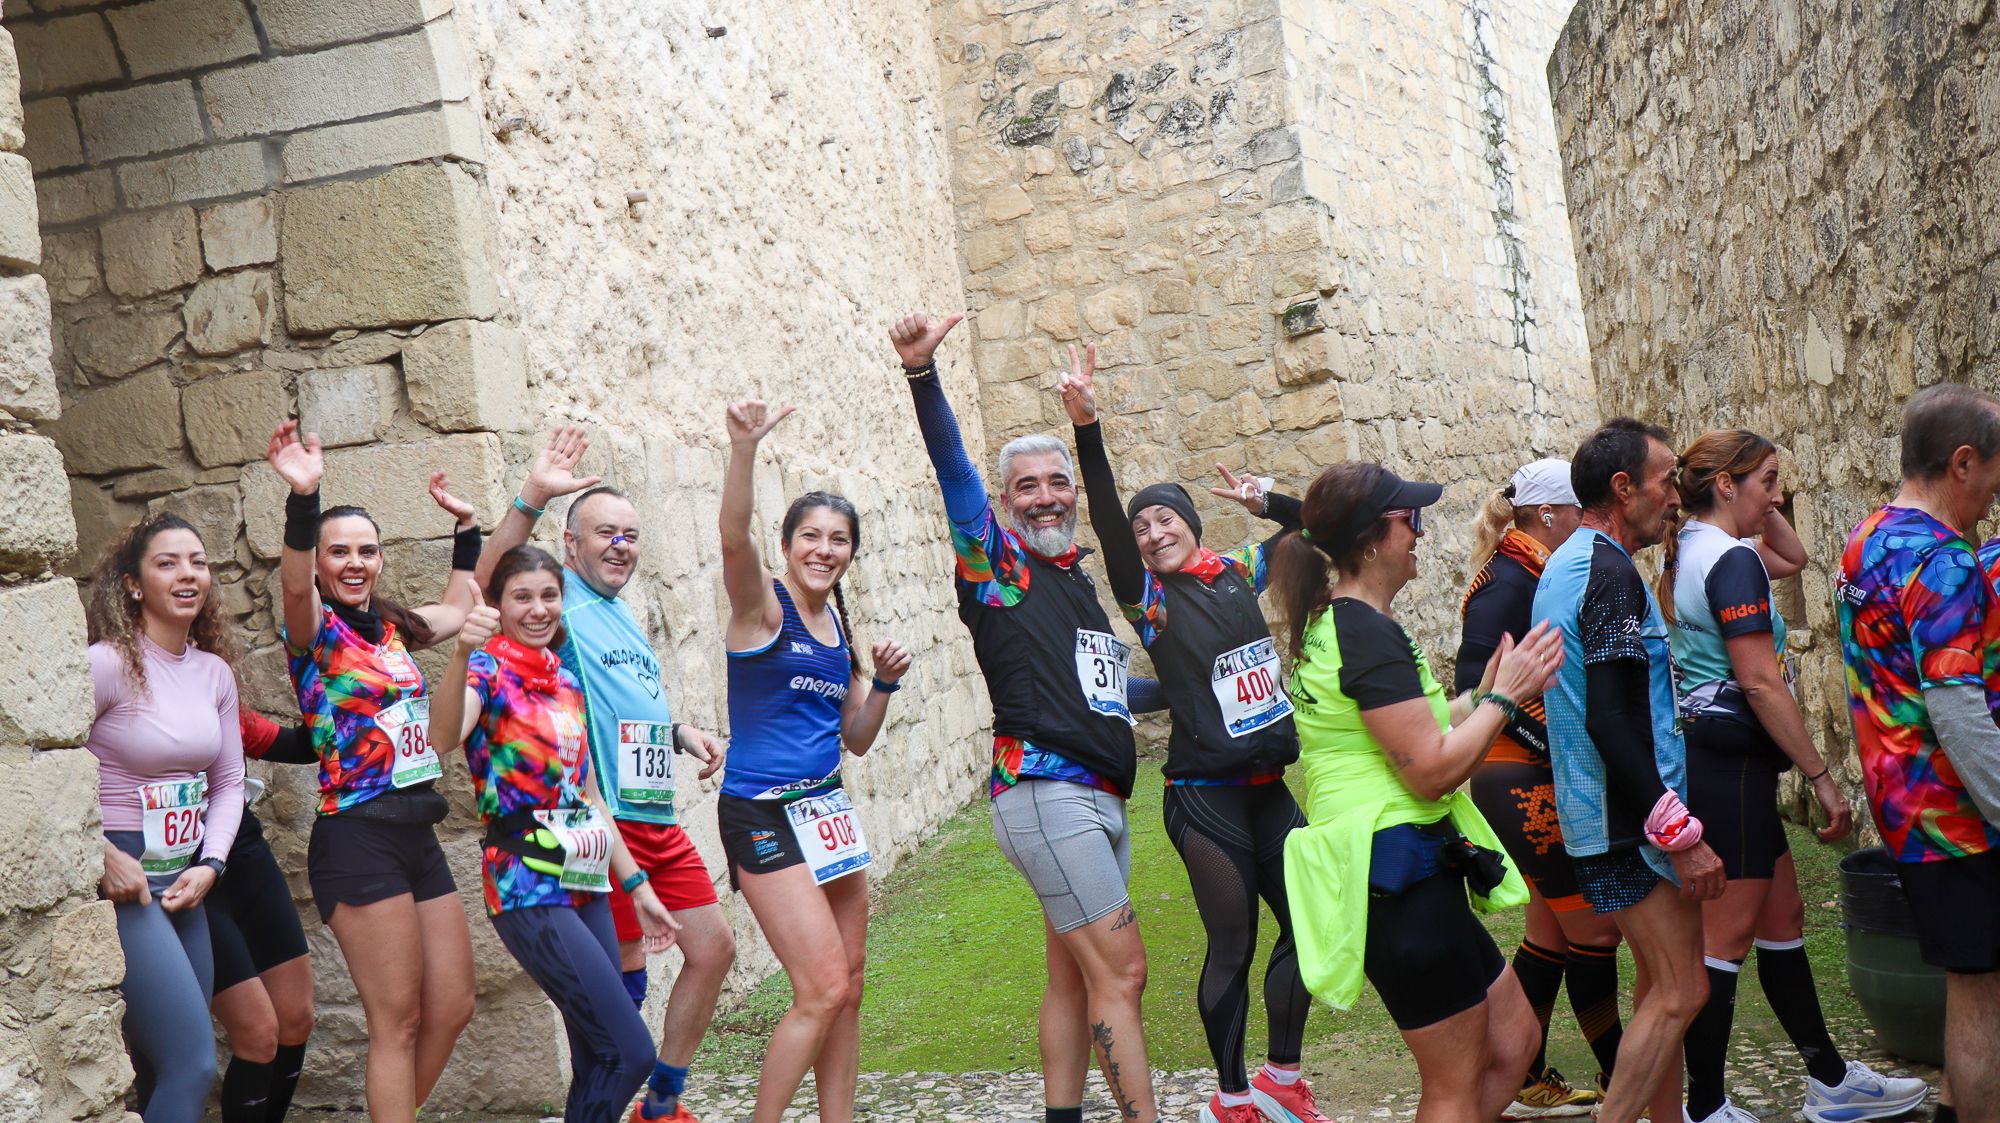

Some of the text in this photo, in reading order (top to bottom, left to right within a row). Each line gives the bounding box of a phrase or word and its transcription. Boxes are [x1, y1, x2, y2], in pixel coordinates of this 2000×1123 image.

[789, 675, 848, 701] enerplu
[1236, 667, 1274, 705] 400
[626, 724, 653, 745] 10K
[1516, 725, 1547, 752] KIPRUN
[631, 746, 672, 779] 1332
[151, 783, 181, 809] 10K
[566, 827, 608, 862] 1010
[817, 814, 857, 851] 908
